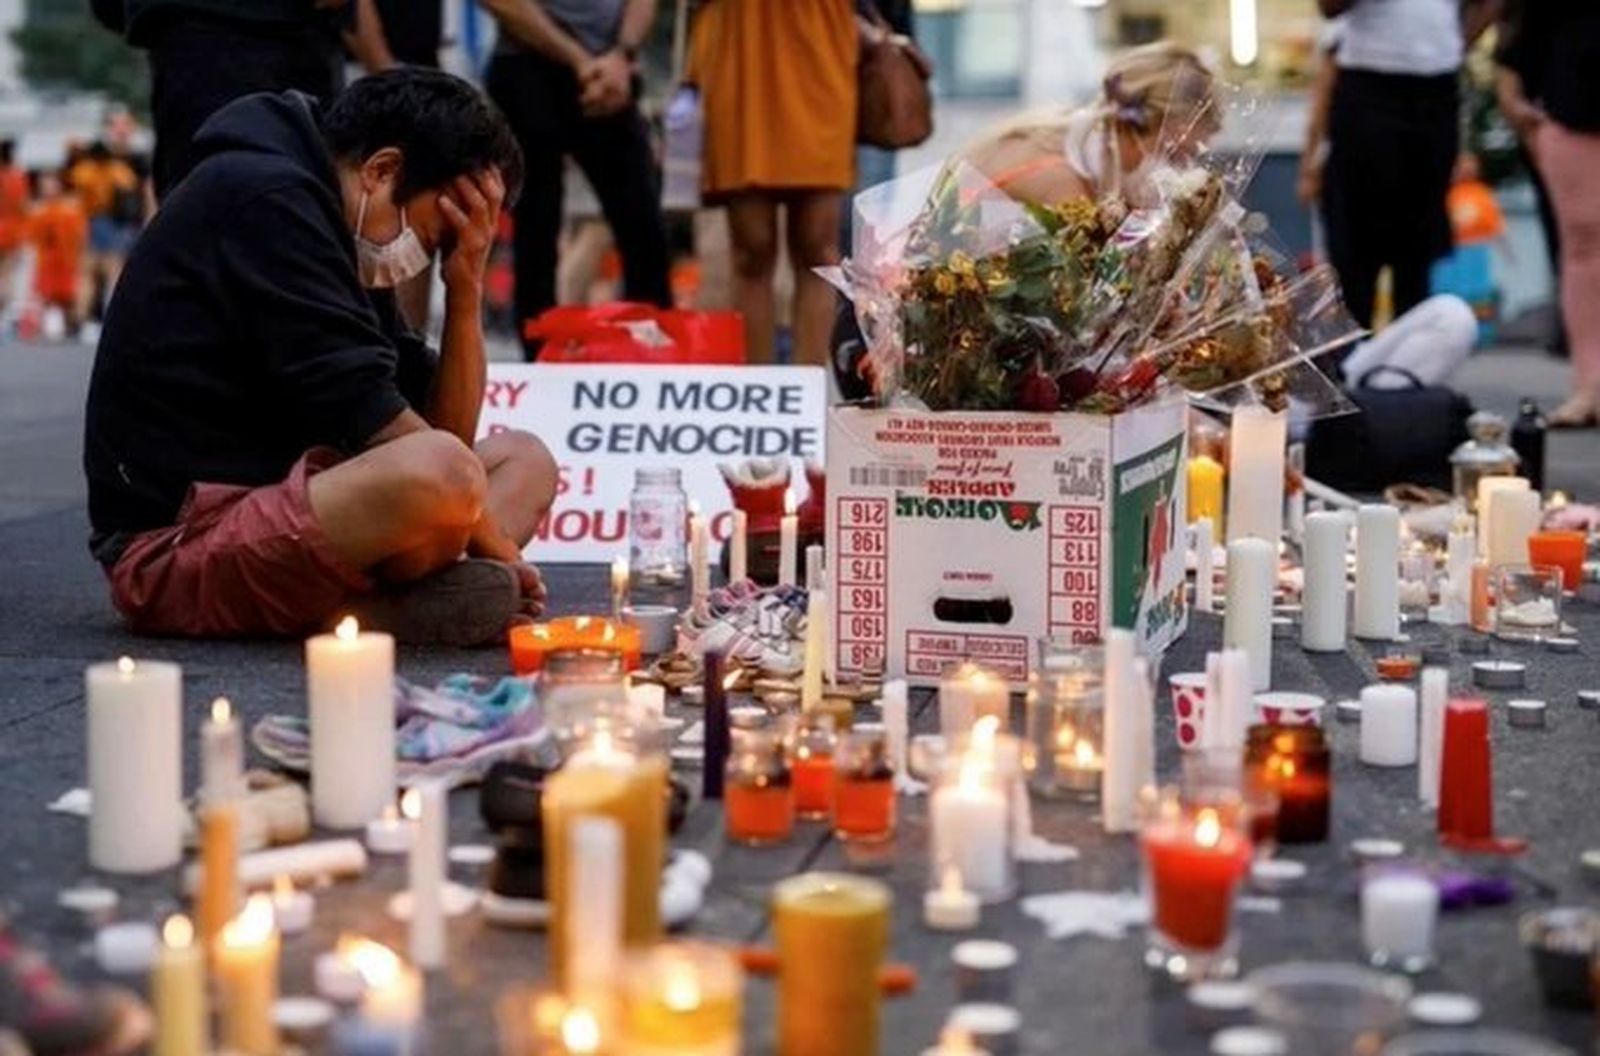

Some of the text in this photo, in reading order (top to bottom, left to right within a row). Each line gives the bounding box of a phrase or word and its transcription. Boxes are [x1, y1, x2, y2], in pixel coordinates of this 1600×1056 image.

[573, 382, 804, 415] NO MORE
[567, 423, 817, 457] GENOCIDE
[852, 502, 883, 523] 216
[1065, 512, 1095, 533] 125
[852, 532, 882, 551] 198
[1065, 541, 1095, 562] 113
[852, 560, 882, 580] 175
[1064, 571, 1095, 591] 100
[852, 588, 882, 609] 163
[1072, 600, 1095, 621] 88
[852, 617, 882, 638] 150
